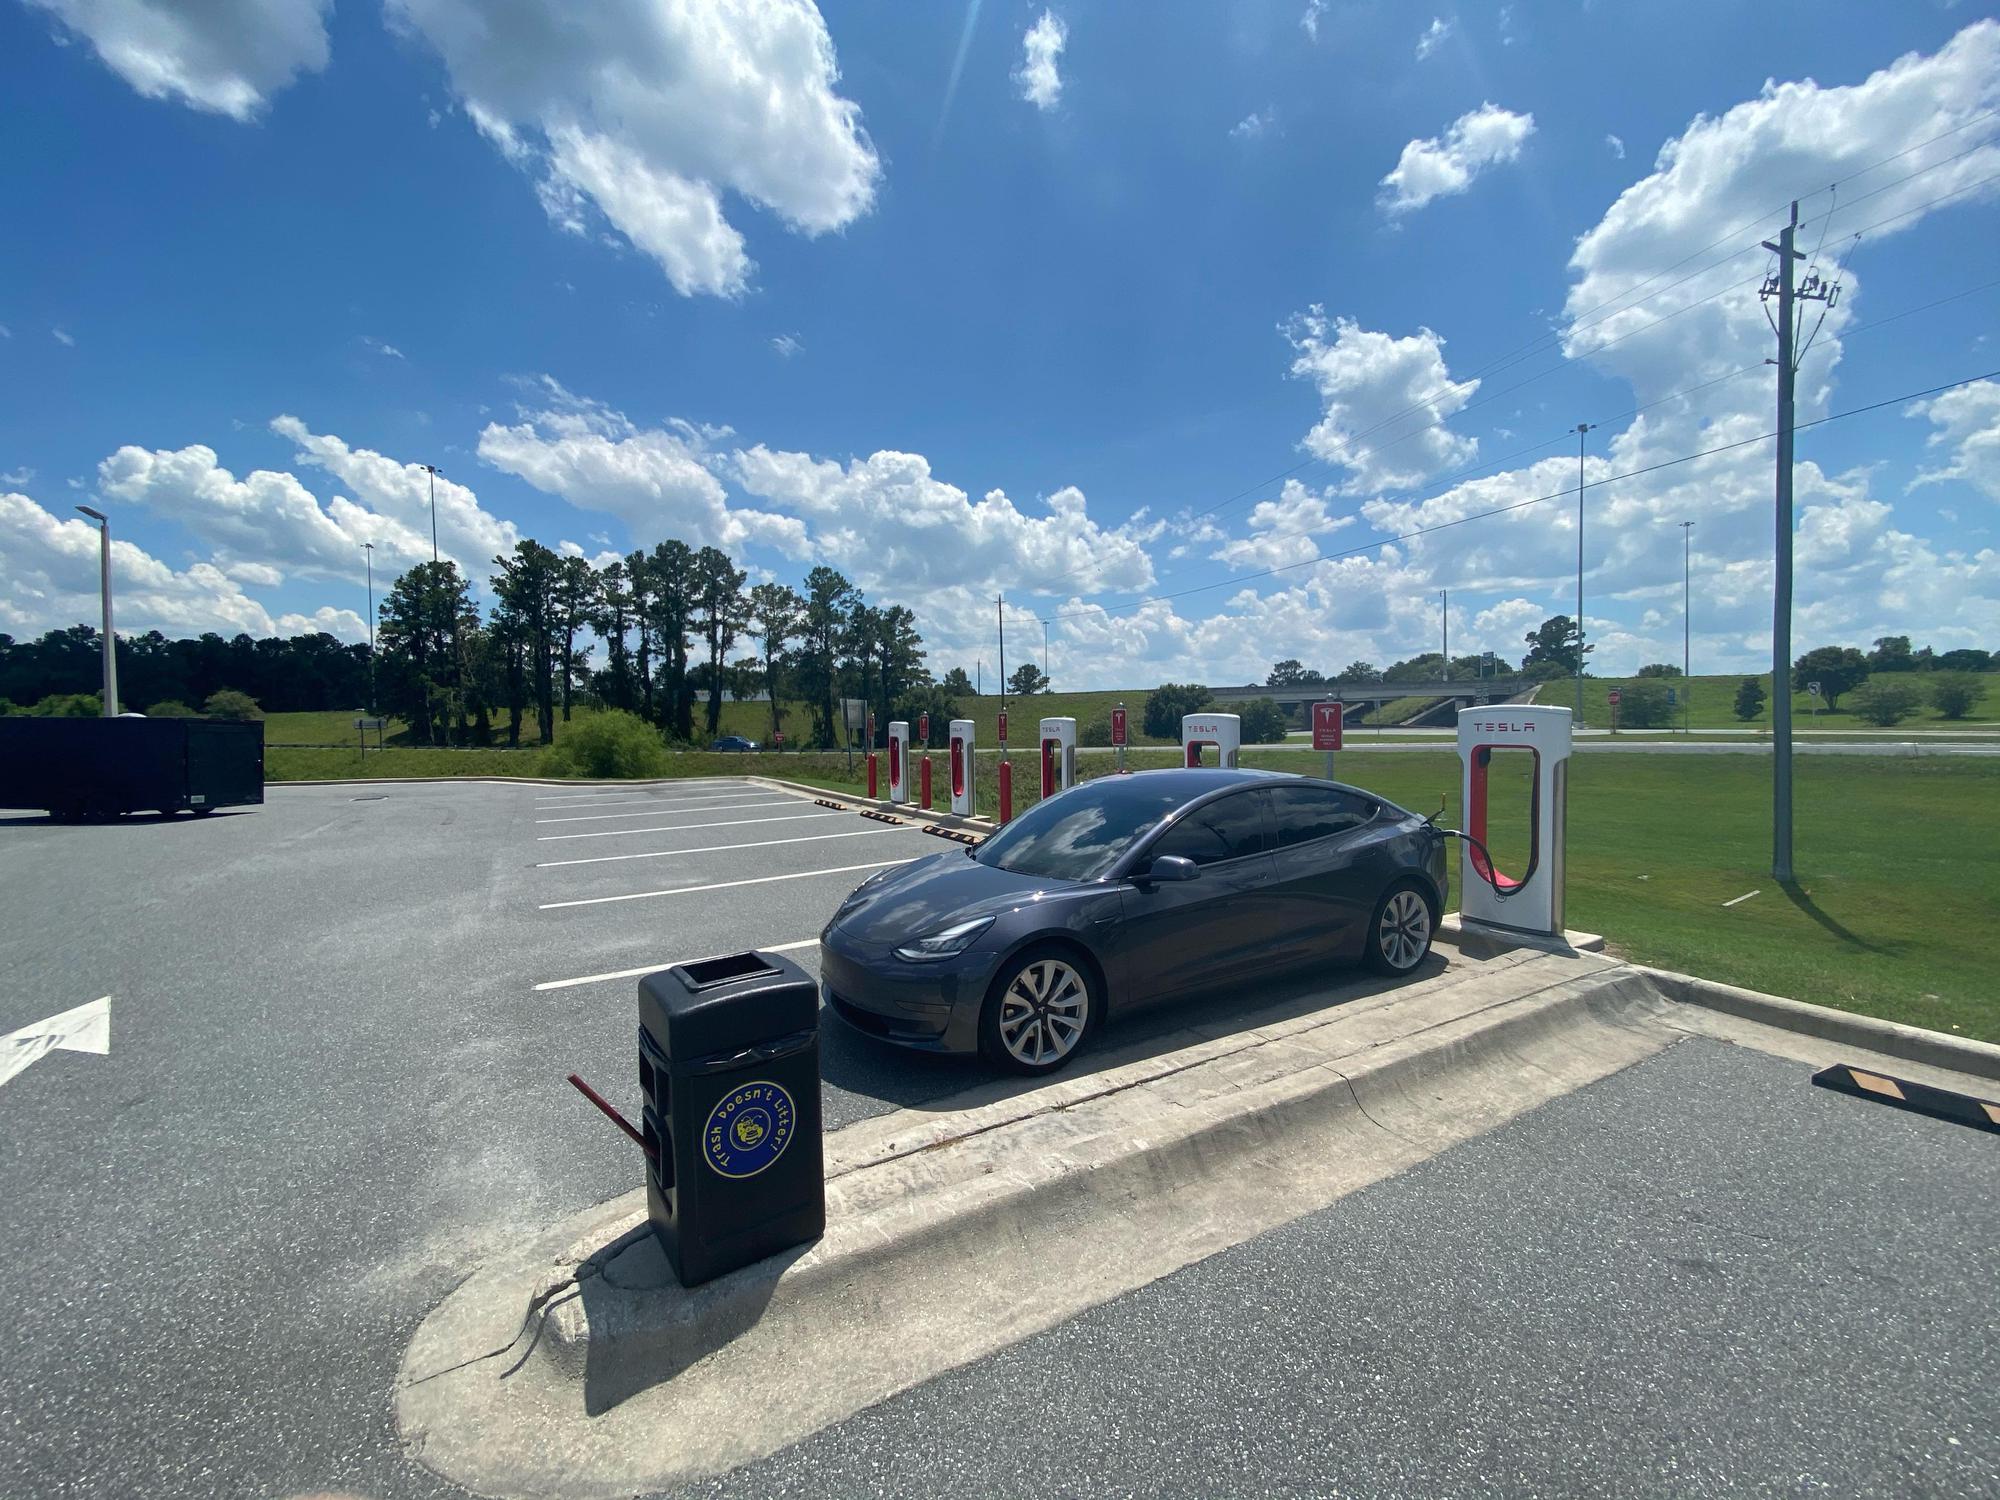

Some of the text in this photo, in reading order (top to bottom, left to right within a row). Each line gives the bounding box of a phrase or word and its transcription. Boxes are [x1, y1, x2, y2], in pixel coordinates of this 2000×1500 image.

[1188, 725, 1217, 733] TESLA
[1474, 723, 1535, 732] TESLA
[711, 1088, 790, 1167] Trash Doesn't Litter!
